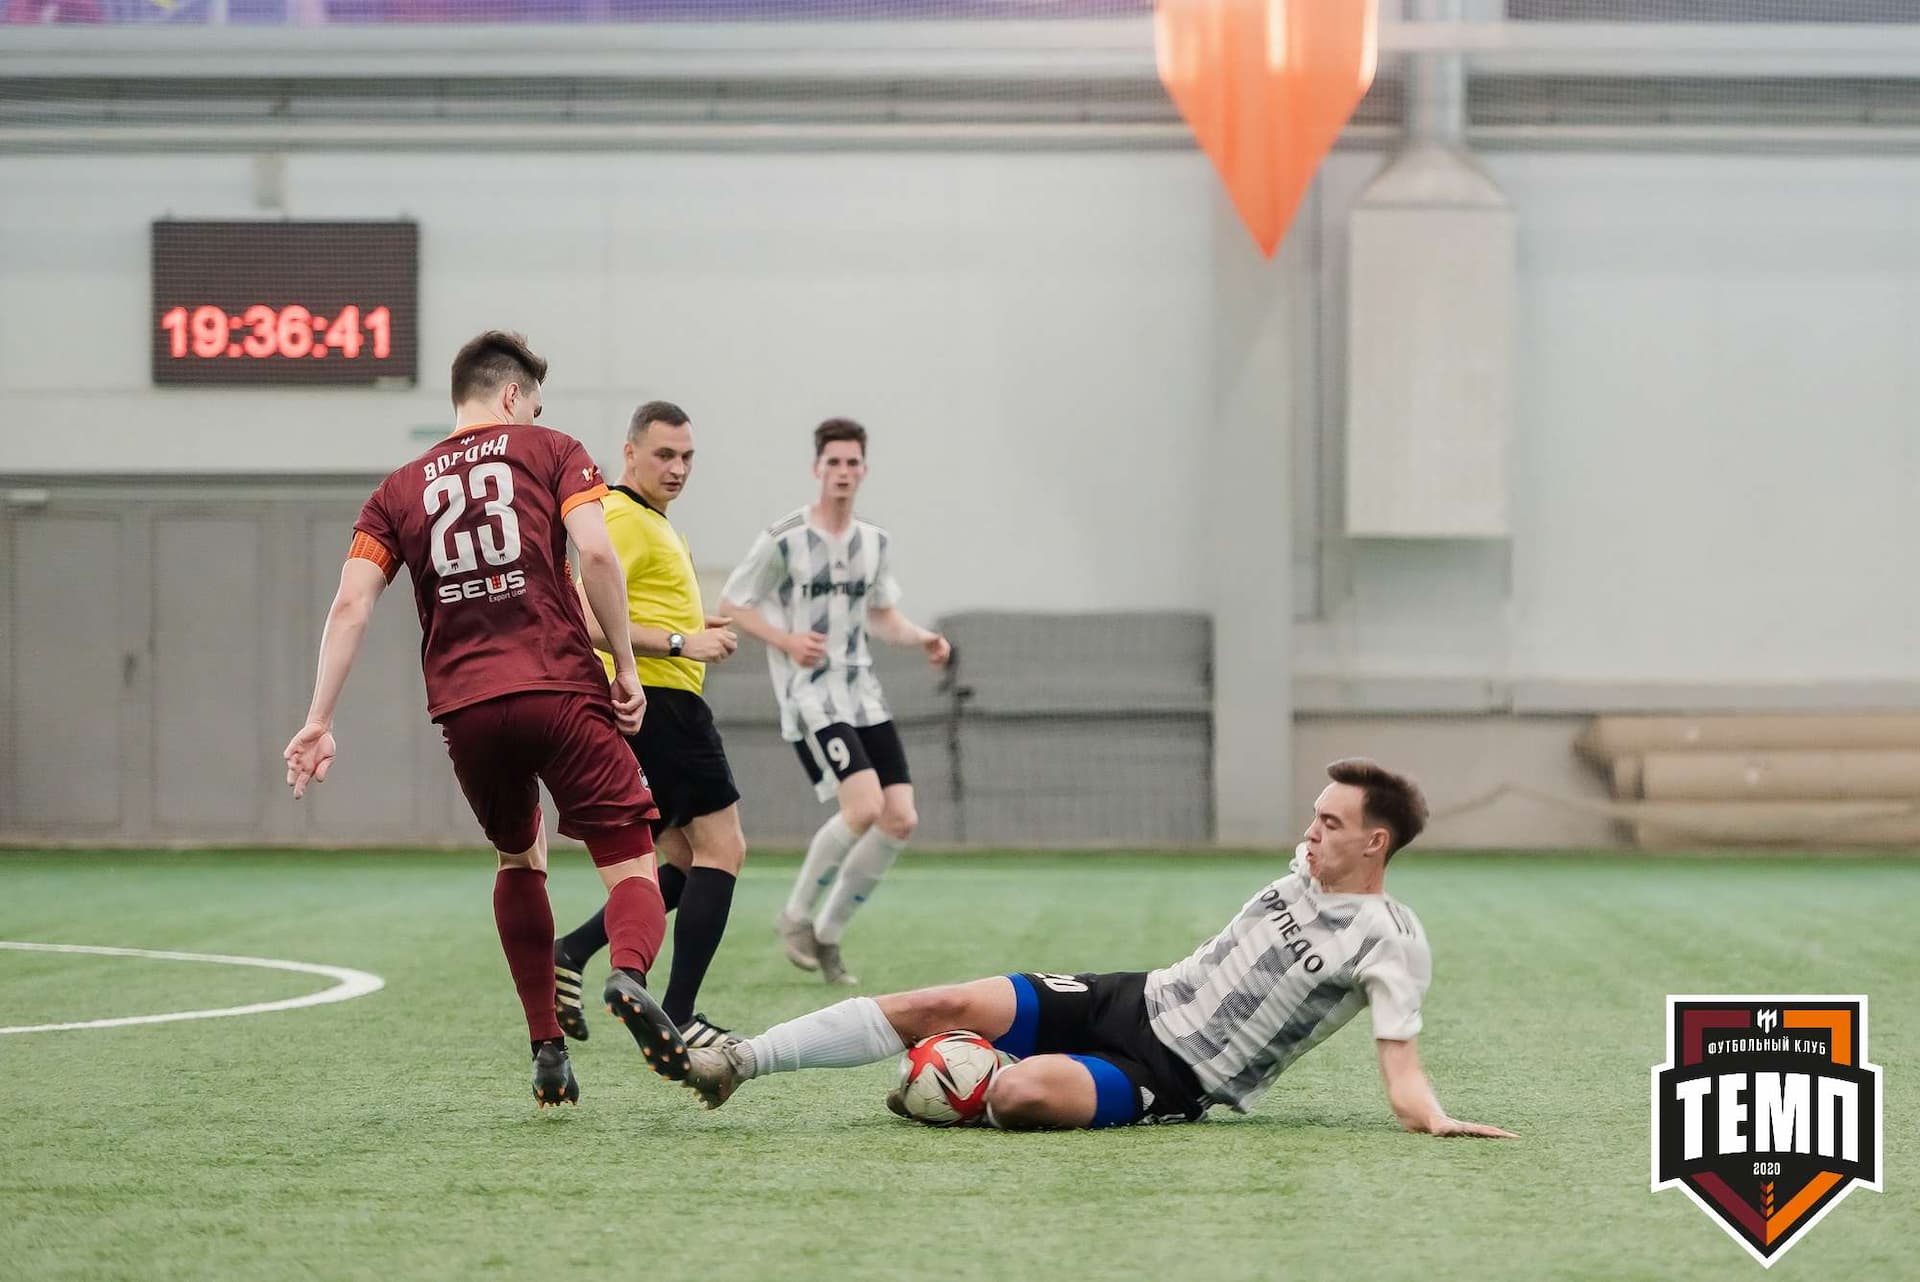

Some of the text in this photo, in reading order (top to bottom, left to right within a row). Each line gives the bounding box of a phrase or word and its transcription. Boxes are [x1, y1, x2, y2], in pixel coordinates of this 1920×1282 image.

[162, 304, 391, 359] 19:36:41
[423, 433, 509, 481] ВОРОНА
[422, 461, 522, 578] 23
[438, 569, 526, 604] SEUS
[826, 736, 851, 771] 9
[1260, 888, 1324, 974] ОРПЕДО
